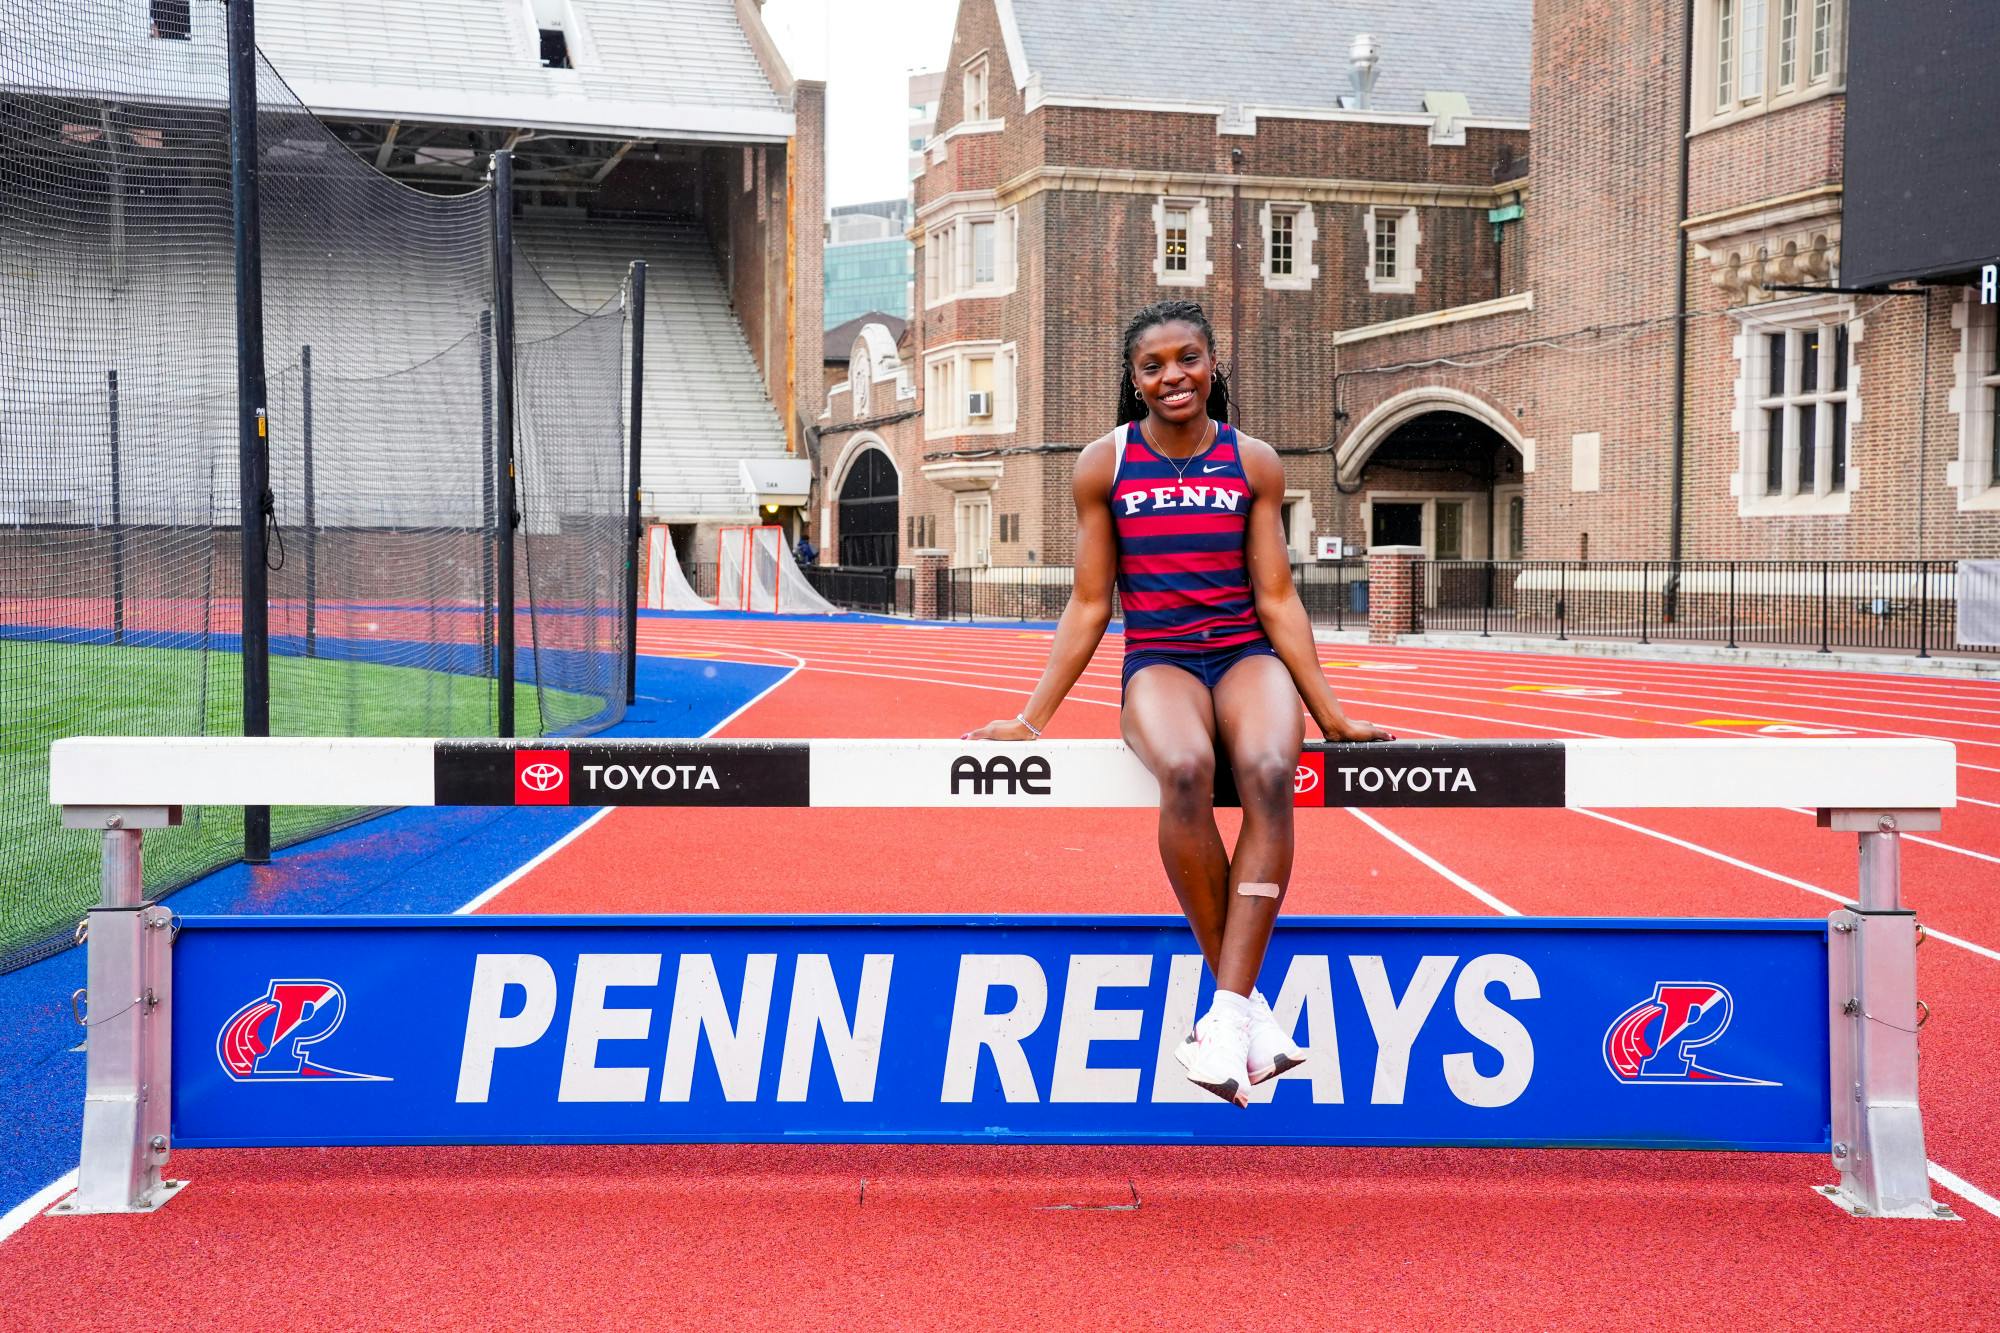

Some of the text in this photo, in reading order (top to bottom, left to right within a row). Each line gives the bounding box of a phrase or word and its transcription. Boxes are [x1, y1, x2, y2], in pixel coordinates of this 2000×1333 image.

[1121, 486, 1243, 515] PENN
[583, 765, 720, 790] TOYOTA
[1338, 766, 1477, 792] TOYOTA
[456, 953, 1541, 1108] PENN RELAYS
